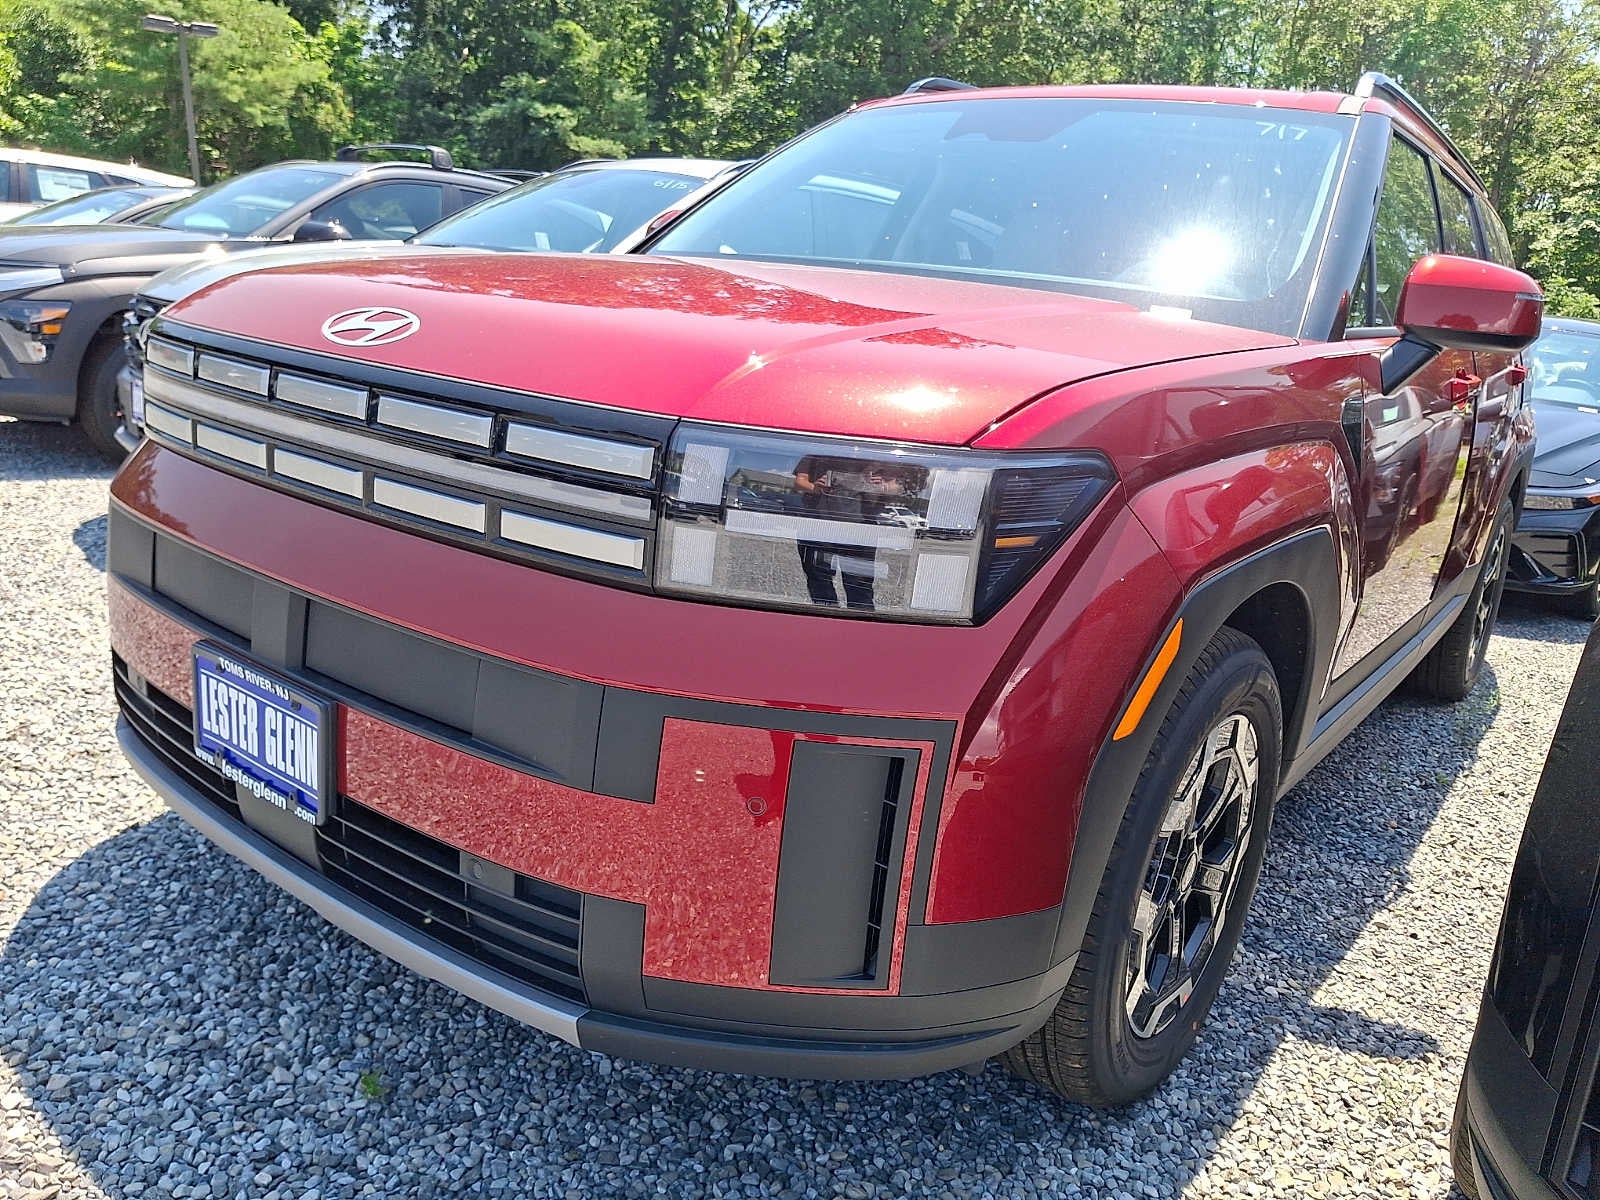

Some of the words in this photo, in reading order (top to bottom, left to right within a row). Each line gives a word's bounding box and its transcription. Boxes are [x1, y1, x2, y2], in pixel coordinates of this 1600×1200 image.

[218, 657, 244, 679] TOMS
[275, 684, 289, 701] NJ
[201, 673, 258, 758] LESTER
[265, 706, 318, 791] GLENN
